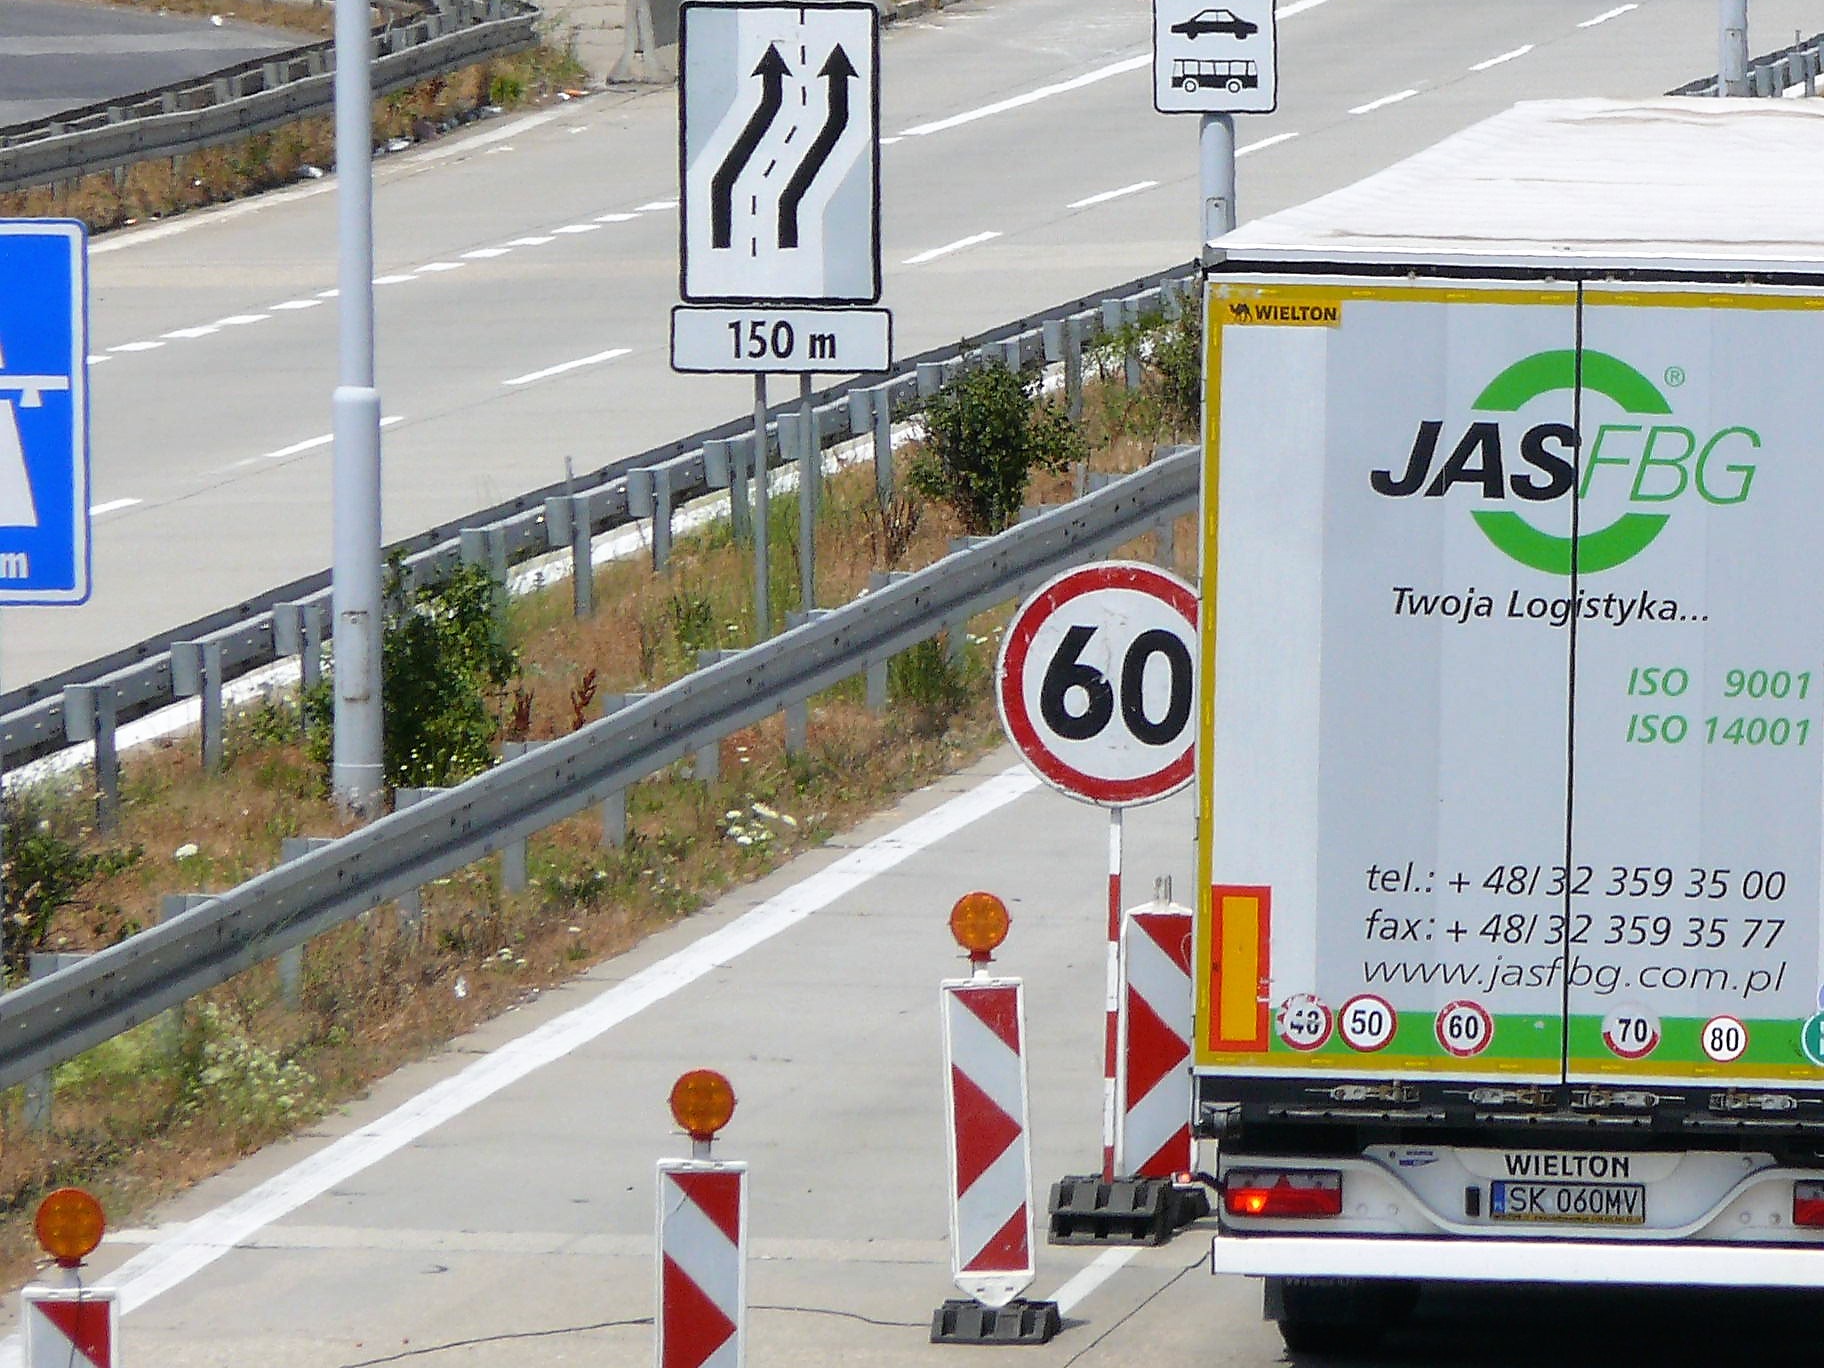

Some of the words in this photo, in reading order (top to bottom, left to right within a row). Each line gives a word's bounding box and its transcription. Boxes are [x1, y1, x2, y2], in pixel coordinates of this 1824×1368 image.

[1256, 305, 1337, 321] WIELTON
[727, 320, 794, 359] 150
[808, 332, 836, 359] m
[1392, 587, 1493, 619] Twoja
[1507, 588, 1709, 627] Logistyka...
[1040, 625, 1193, 746] 60
[1627, 668, 1689, 698] ISO
[1723, 669, 1812, 701] 9001
[1626, 714, 1688, 745] ISO
[1704, 716, 1812, 747] 14001
[1605, 867, 1673, 897] 359
[1684, 868, 1731, 899] 35
[1742, 870, 1787, 901] 00
[1366, 908, 1436, 941] fax:
[1604, 915, 1672, 946] 359
[1682, 918, 1729, 948] 35
[1742, 919, 1786, 949] 77
[1364, 954, 1787, 1000] www.jasfbg.com.pl
[1351, 1009, 1384, 1037] 50
[1449, 1015, 1479, 1040] 60
[1618, 1018, 1648, 1043] 70
[1710, 1027, 1740, 1052] 80
[1505, 1154, 1630, 1178] WIELTON
[1510, 1187, 1546, 1213] SK
[1557, 1188, 1639, 1214] 060MV
